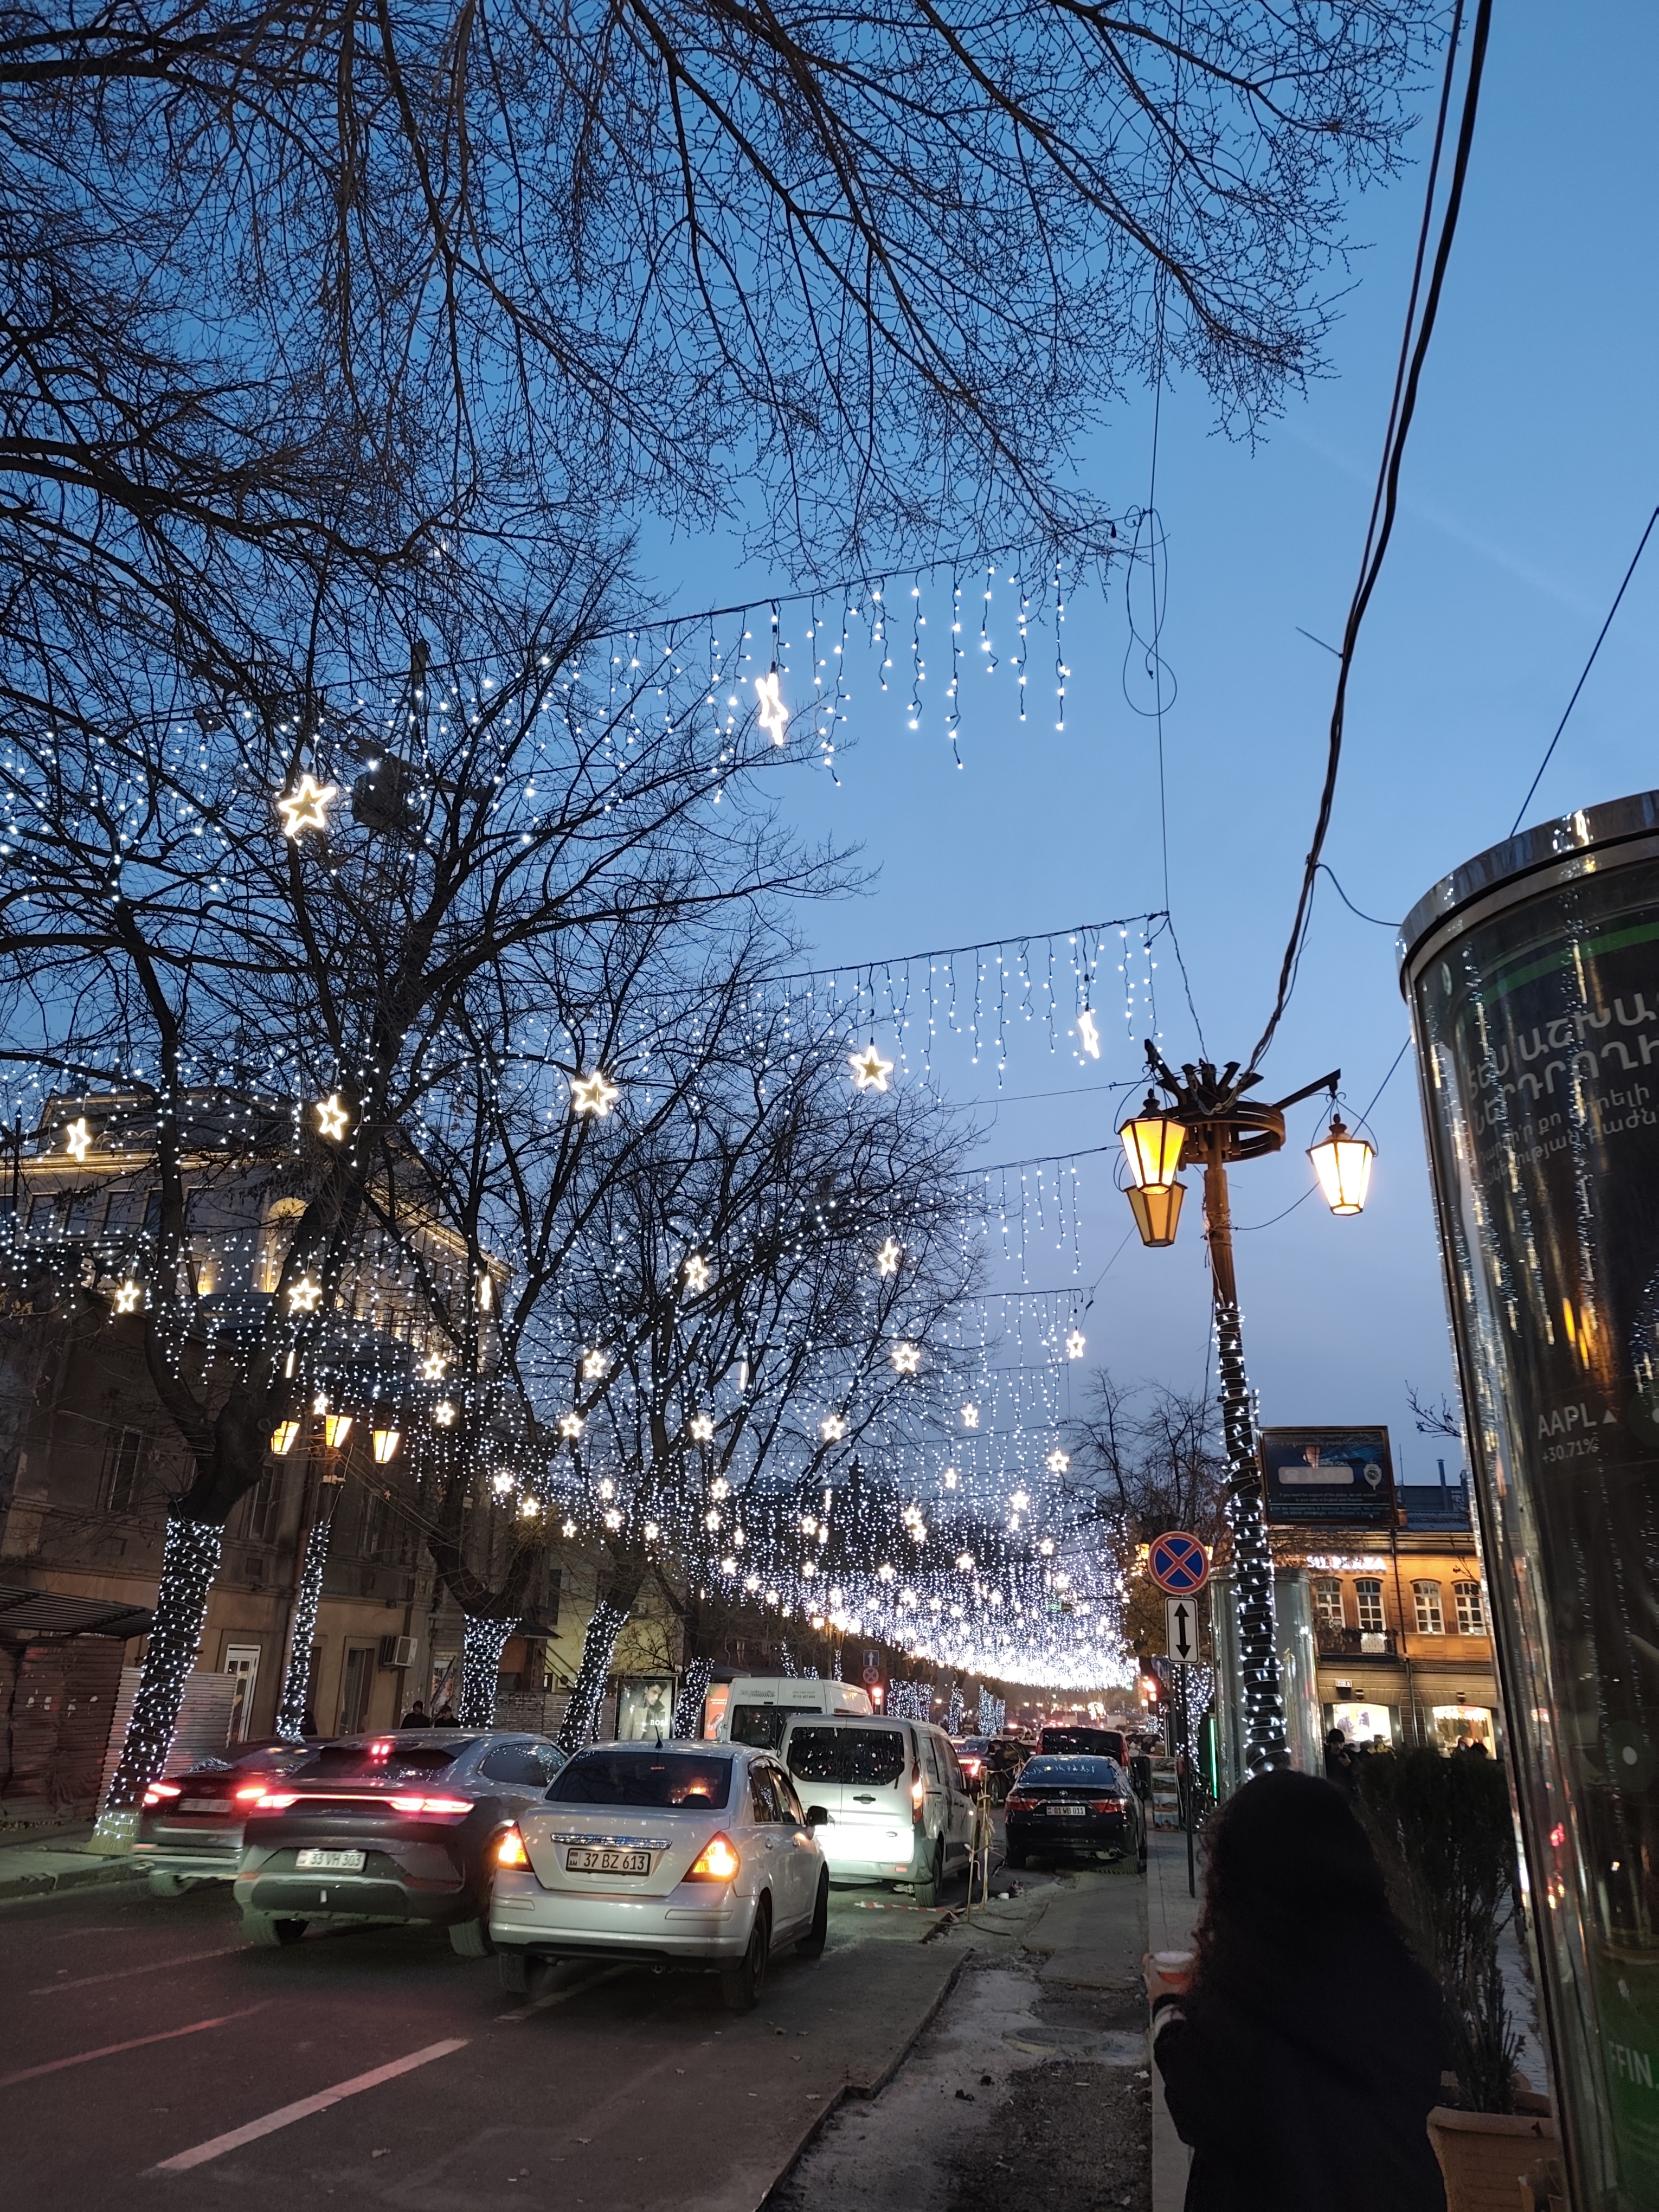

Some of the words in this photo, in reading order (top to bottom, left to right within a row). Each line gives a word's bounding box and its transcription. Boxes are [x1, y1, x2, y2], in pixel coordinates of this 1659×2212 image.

[1518, 992, 1659, 1061] ԱՇԽԱ
[1538, 1403, 1598, 1440] AAPL
[1541, 1436, 1600, 1464] +30.71%
[1332, 1557, 1386, 1570] PLAZA
[311, 1853, 325, 1865] 33
[342, 1854, 362, 1866] 303
[584, 1853, 599, 1868] 37
[602, 1854, 619, 1869] BZ
[623, 1855, 645, 1870] 613
